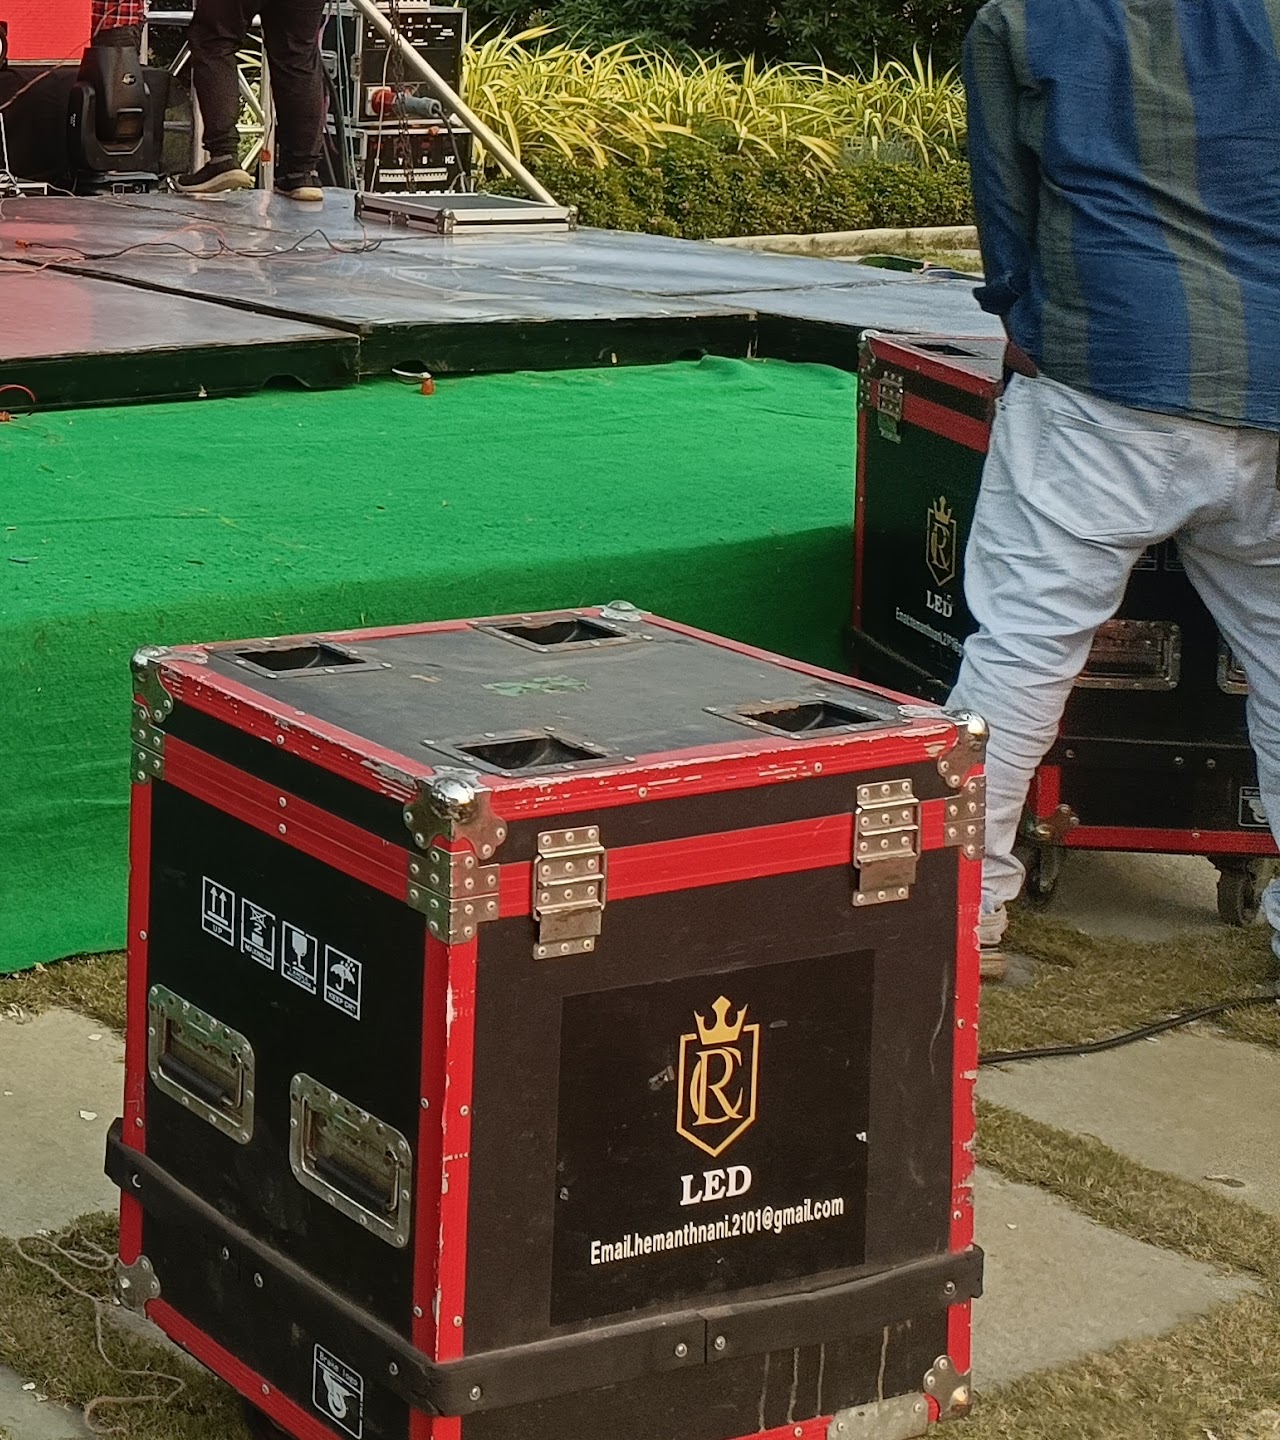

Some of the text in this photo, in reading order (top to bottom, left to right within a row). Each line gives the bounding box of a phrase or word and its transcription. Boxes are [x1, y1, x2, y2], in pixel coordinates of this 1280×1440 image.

[926, 589, 953, 618] LED
[212, 924, 223, 935] UP
[253, 922, 263, 935] 2
[679, 1164, 753, 1207] LED
